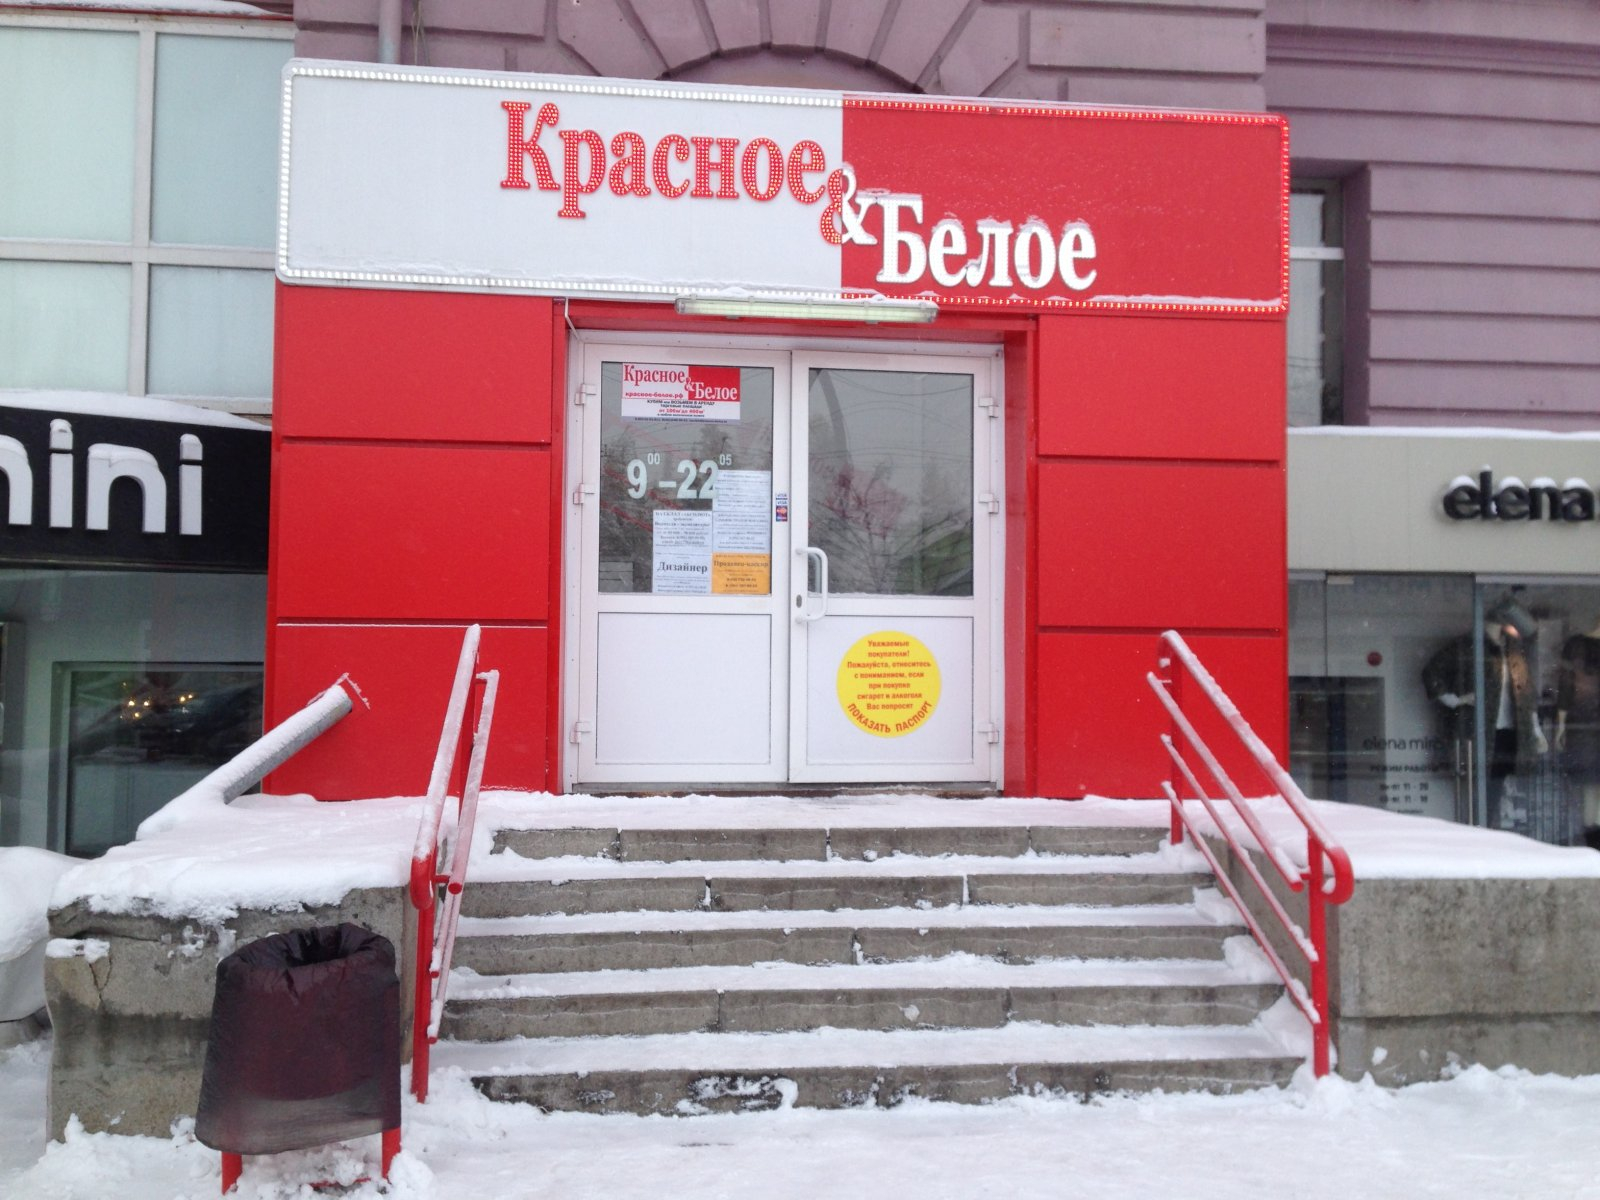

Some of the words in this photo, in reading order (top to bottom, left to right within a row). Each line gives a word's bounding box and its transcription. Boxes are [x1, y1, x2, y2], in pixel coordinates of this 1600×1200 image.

[500, 101, 827, 219] Красное
[875, 193, 1098, 291] Белое
[623, 364, 685, 386] Красное
[694, 382, 738, 400] Белое
[627, 459, 648, 499] 9
[647, 452, 660, 465] 00
[719, 454, 732, 466] 05
[1443, 466, 1596, 522] elena
[656, 561, 708, 574] Дизайнер
[868, 650, 910, 658] покупатели!
[883, 682, 910, 690] покупке
[857, 693, 884, 701] сигарет
[881, 703, 913, 711] попросят
[848, 703, 891, 733] ПОКАЗАТЬ
[895, 701, 932, 732] ПАСПОРТ
